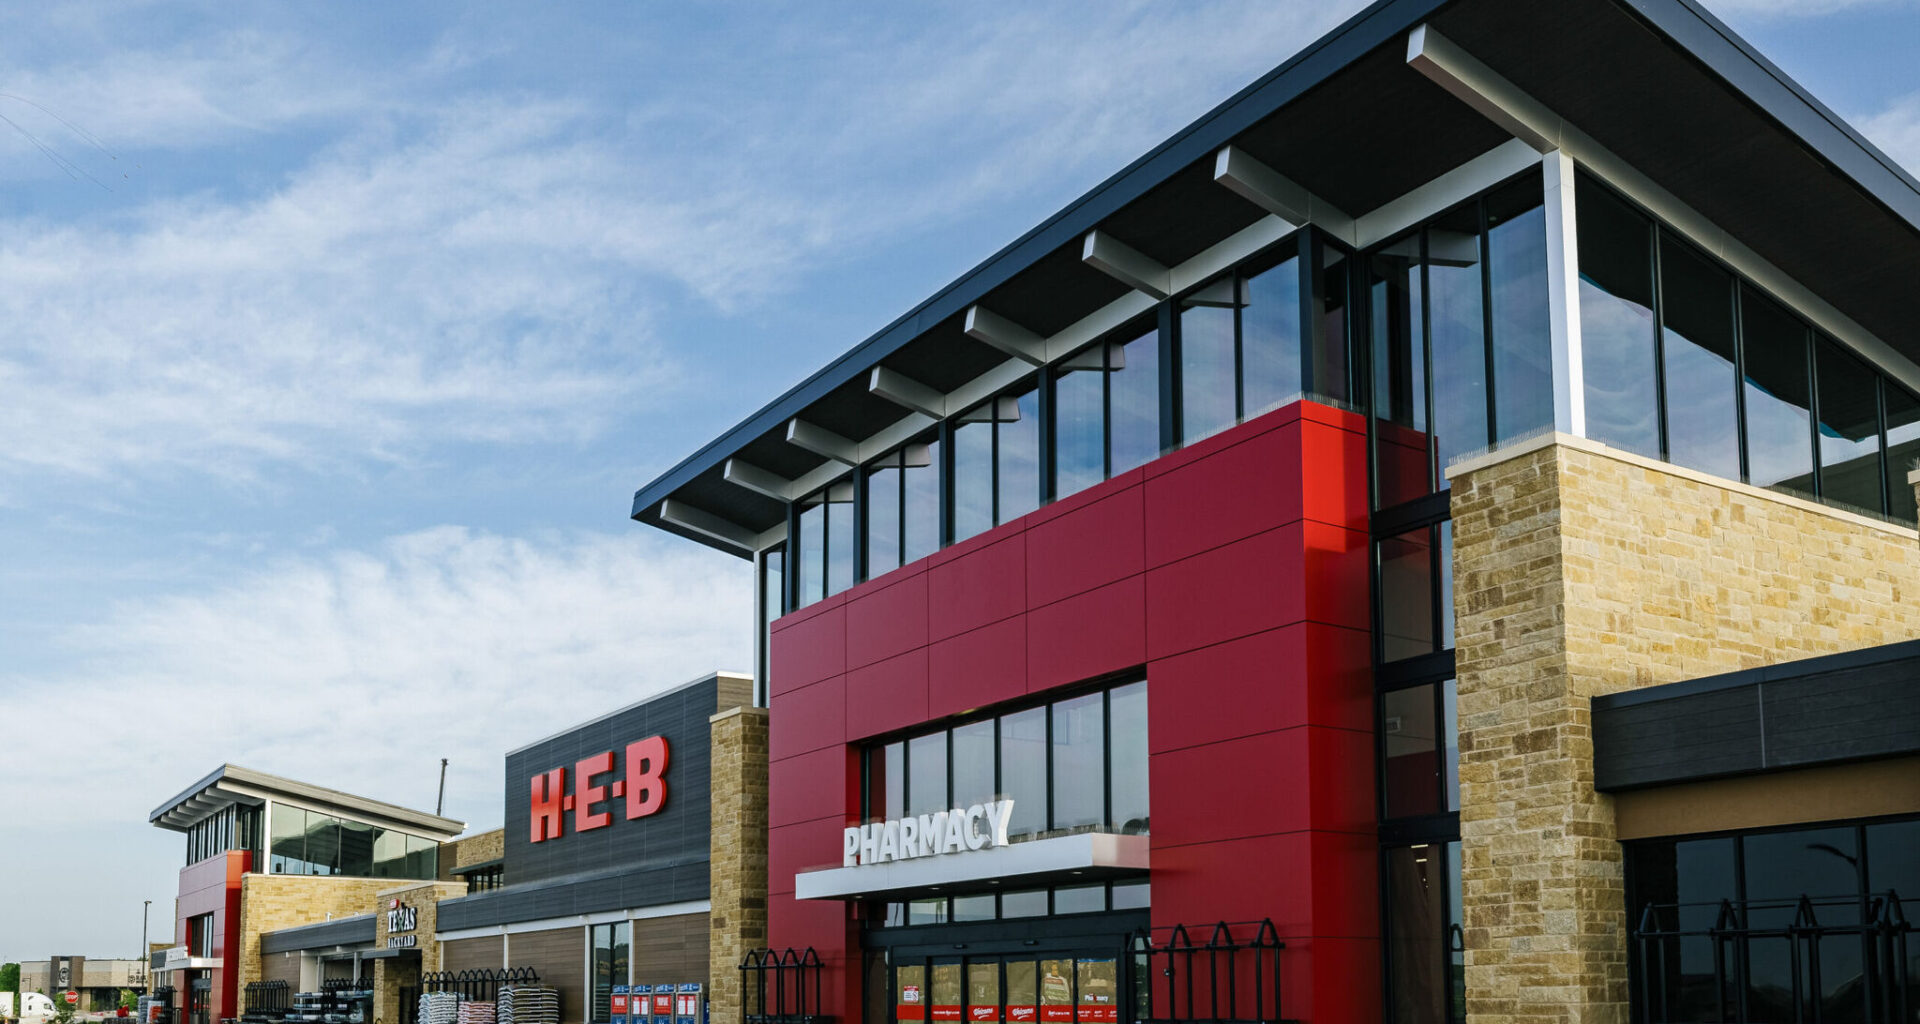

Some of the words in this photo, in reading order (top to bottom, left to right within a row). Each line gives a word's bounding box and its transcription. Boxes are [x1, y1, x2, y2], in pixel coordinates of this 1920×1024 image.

[530, 735, 669, 843] H-E-B
[843, 799, 1015, 867] PHARMACY
[387, 906, 416, 933] TEXAS
